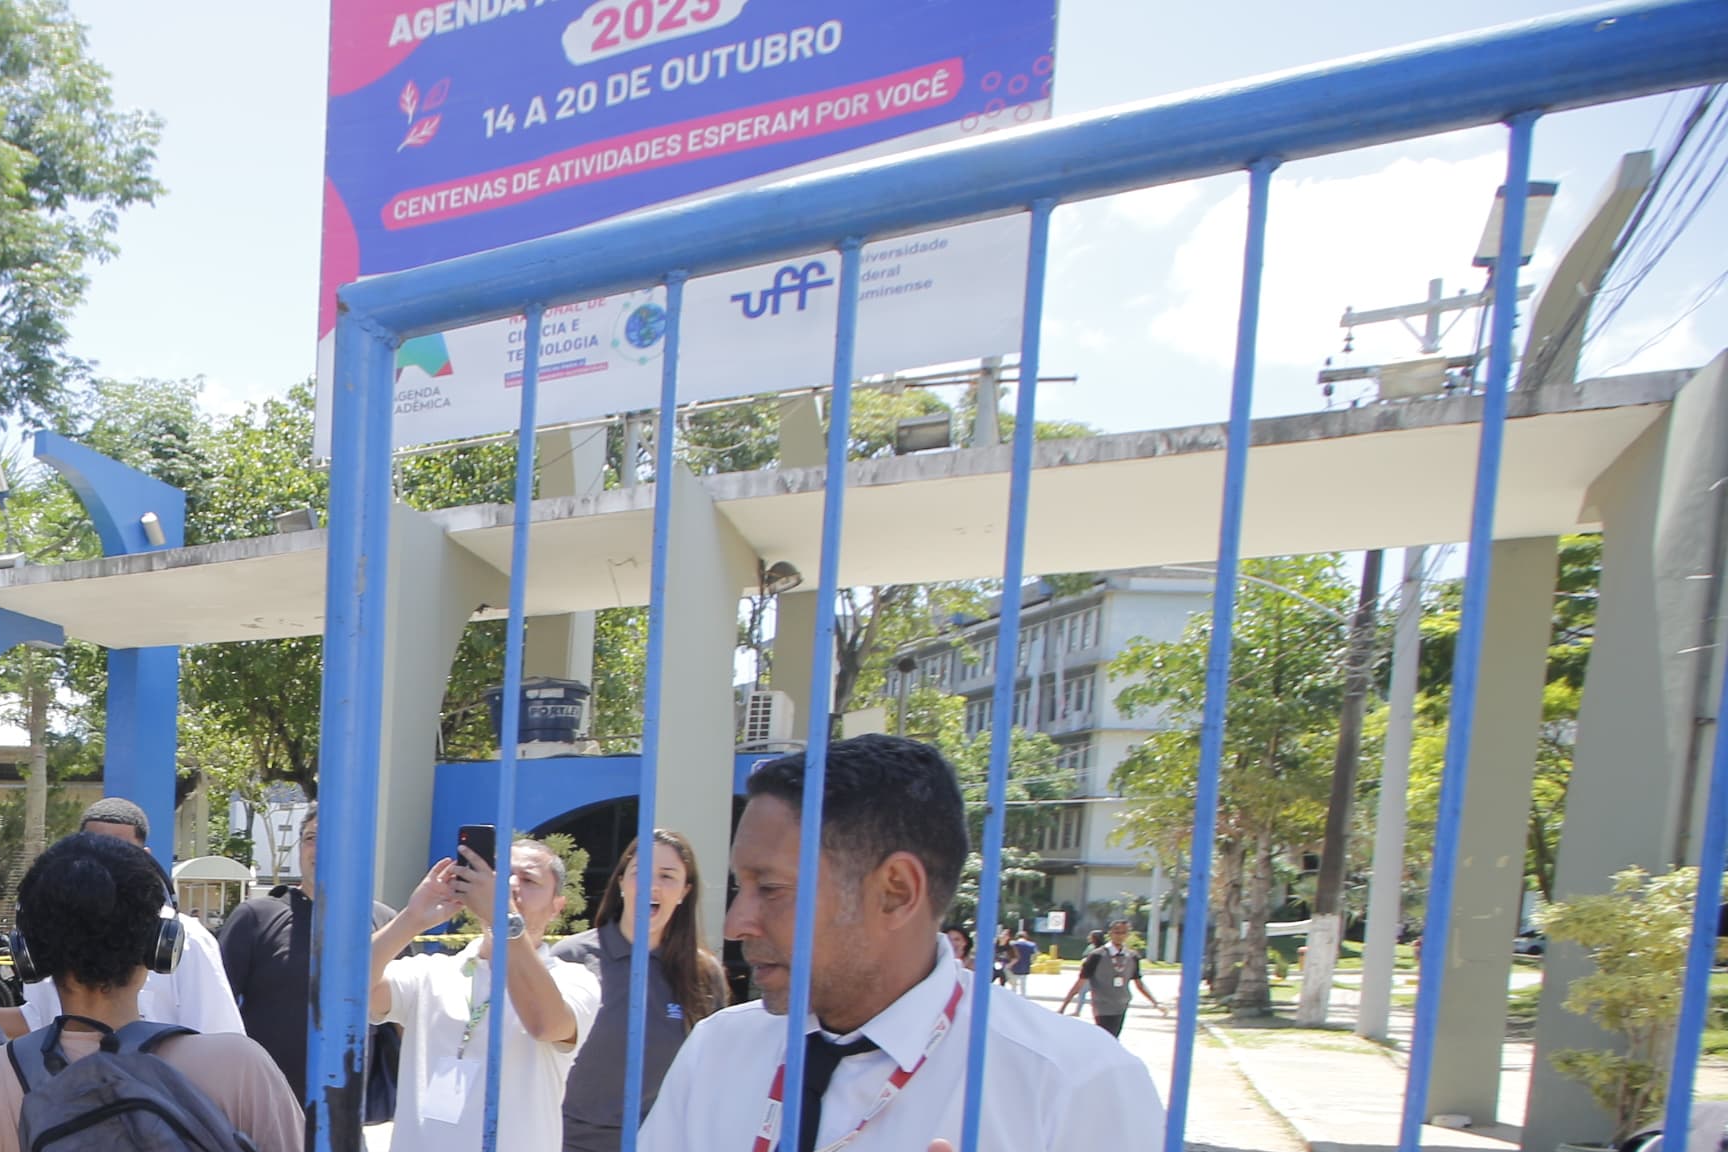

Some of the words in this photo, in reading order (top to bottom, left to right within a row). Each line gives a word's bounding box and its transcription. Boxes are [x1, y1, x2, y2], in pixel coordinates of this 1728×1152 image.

[483, 104, 516, 138] 14
[524, 97, 547, 129] A
[556, 80, 597, 120] 20
[606, 65, 652, 107] DE
[660, 19, 843, 92] OUTUBRO
[393, 177, 507, 221] CENTENAS
[511, 168, 541, 194] DE
[546, 134, 681, 187] ATIVIDADES
[687, 107, 810, 152] ESPERAM
[815, 93, 870, 125] POR
[876, 69, 950, 111] VOCÊ
[862, 238, 949, 262] iversidade
[862, 264, 901, 282] deral
[730, 261, 834, 319] uff
[508, 321, 566, 344] CICIA
[507, 334, 599, 362] TEOLOGIA
[395, 386, 441, 402] GENDA
